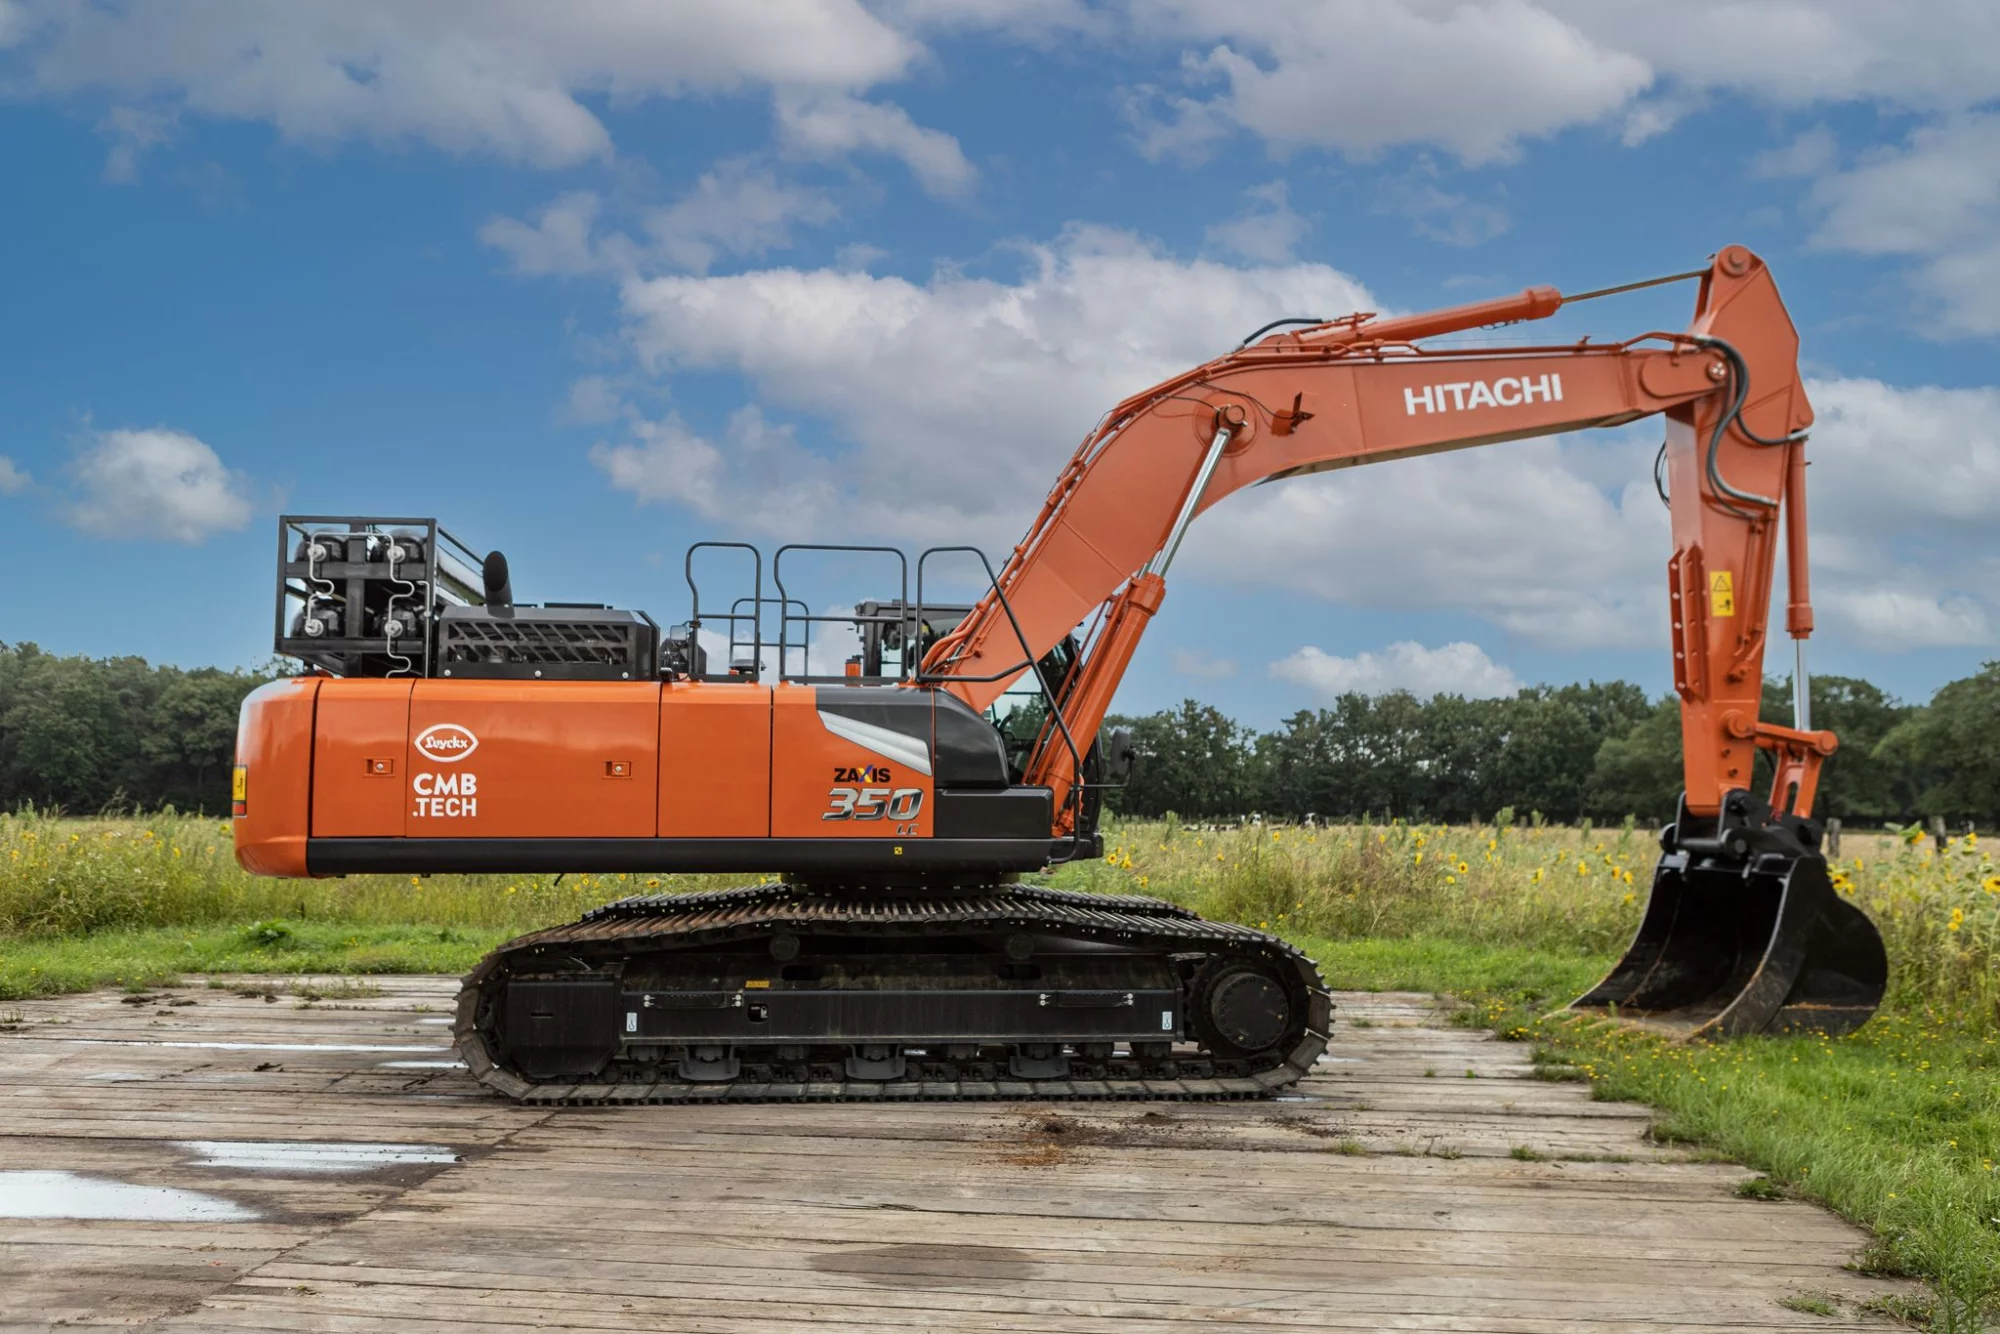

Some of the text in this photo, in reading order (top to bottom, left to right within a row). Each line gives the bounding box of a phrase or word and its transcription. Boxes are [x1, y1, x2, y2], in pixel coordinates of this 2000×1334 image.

[1403, 373, 1563, 416] HITACHI
[413, 773, 477, 795] CMB
[834, 764, 891, 783] ZAXIS
[412, 797, 477, 817] .TECH
[822, 787, 924, 820] 350
[896, 823, 919, 836] LC
